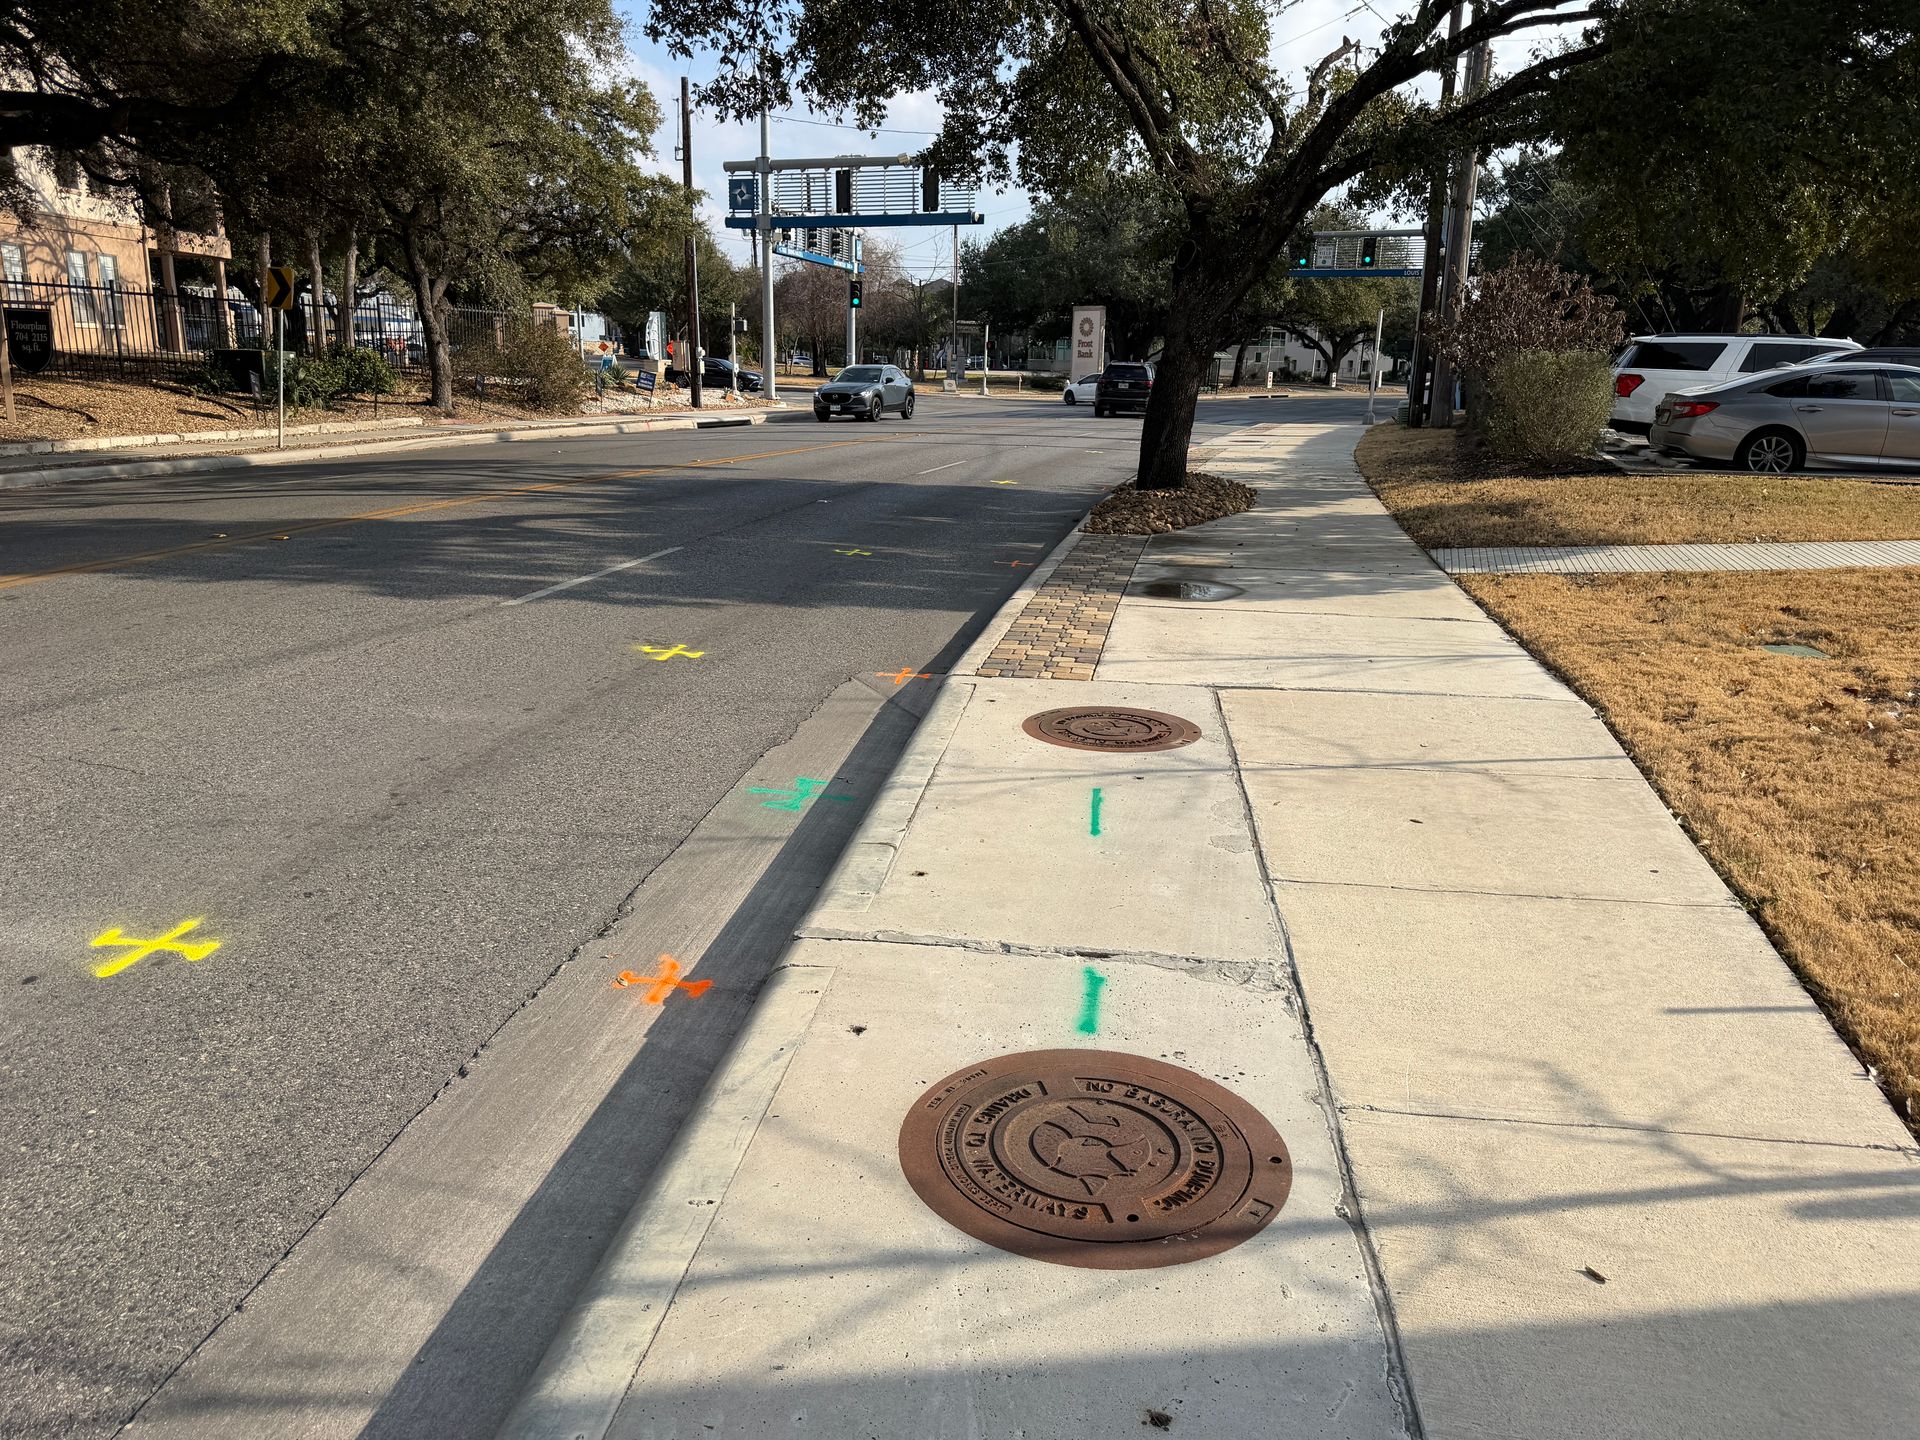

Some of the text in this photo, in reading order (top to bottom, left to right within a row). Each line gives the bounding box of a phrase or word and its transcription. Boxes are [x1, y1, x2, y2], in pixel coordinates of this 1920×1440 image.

[11, 320, 47, 332] Floorplan
[15, 332, 48, 342] 704 2115
[1077, 339, 1093, 348] Frost
[1077, 349, 1093, 358] Bank
[953, 1104, 967, 1117] SAN
[1086, 1081, 1114, 1093] NO
[1189, 1136, 1215, 1153] NO
[944, 1118, 958, 1145] ANTONIO
[945, 1147, 959, 1171] PUBLIC
[965, 1088, 1089, 1220] DRAINS TO WATERWAYS
[956, 1174, 980, 1195] WORKS
